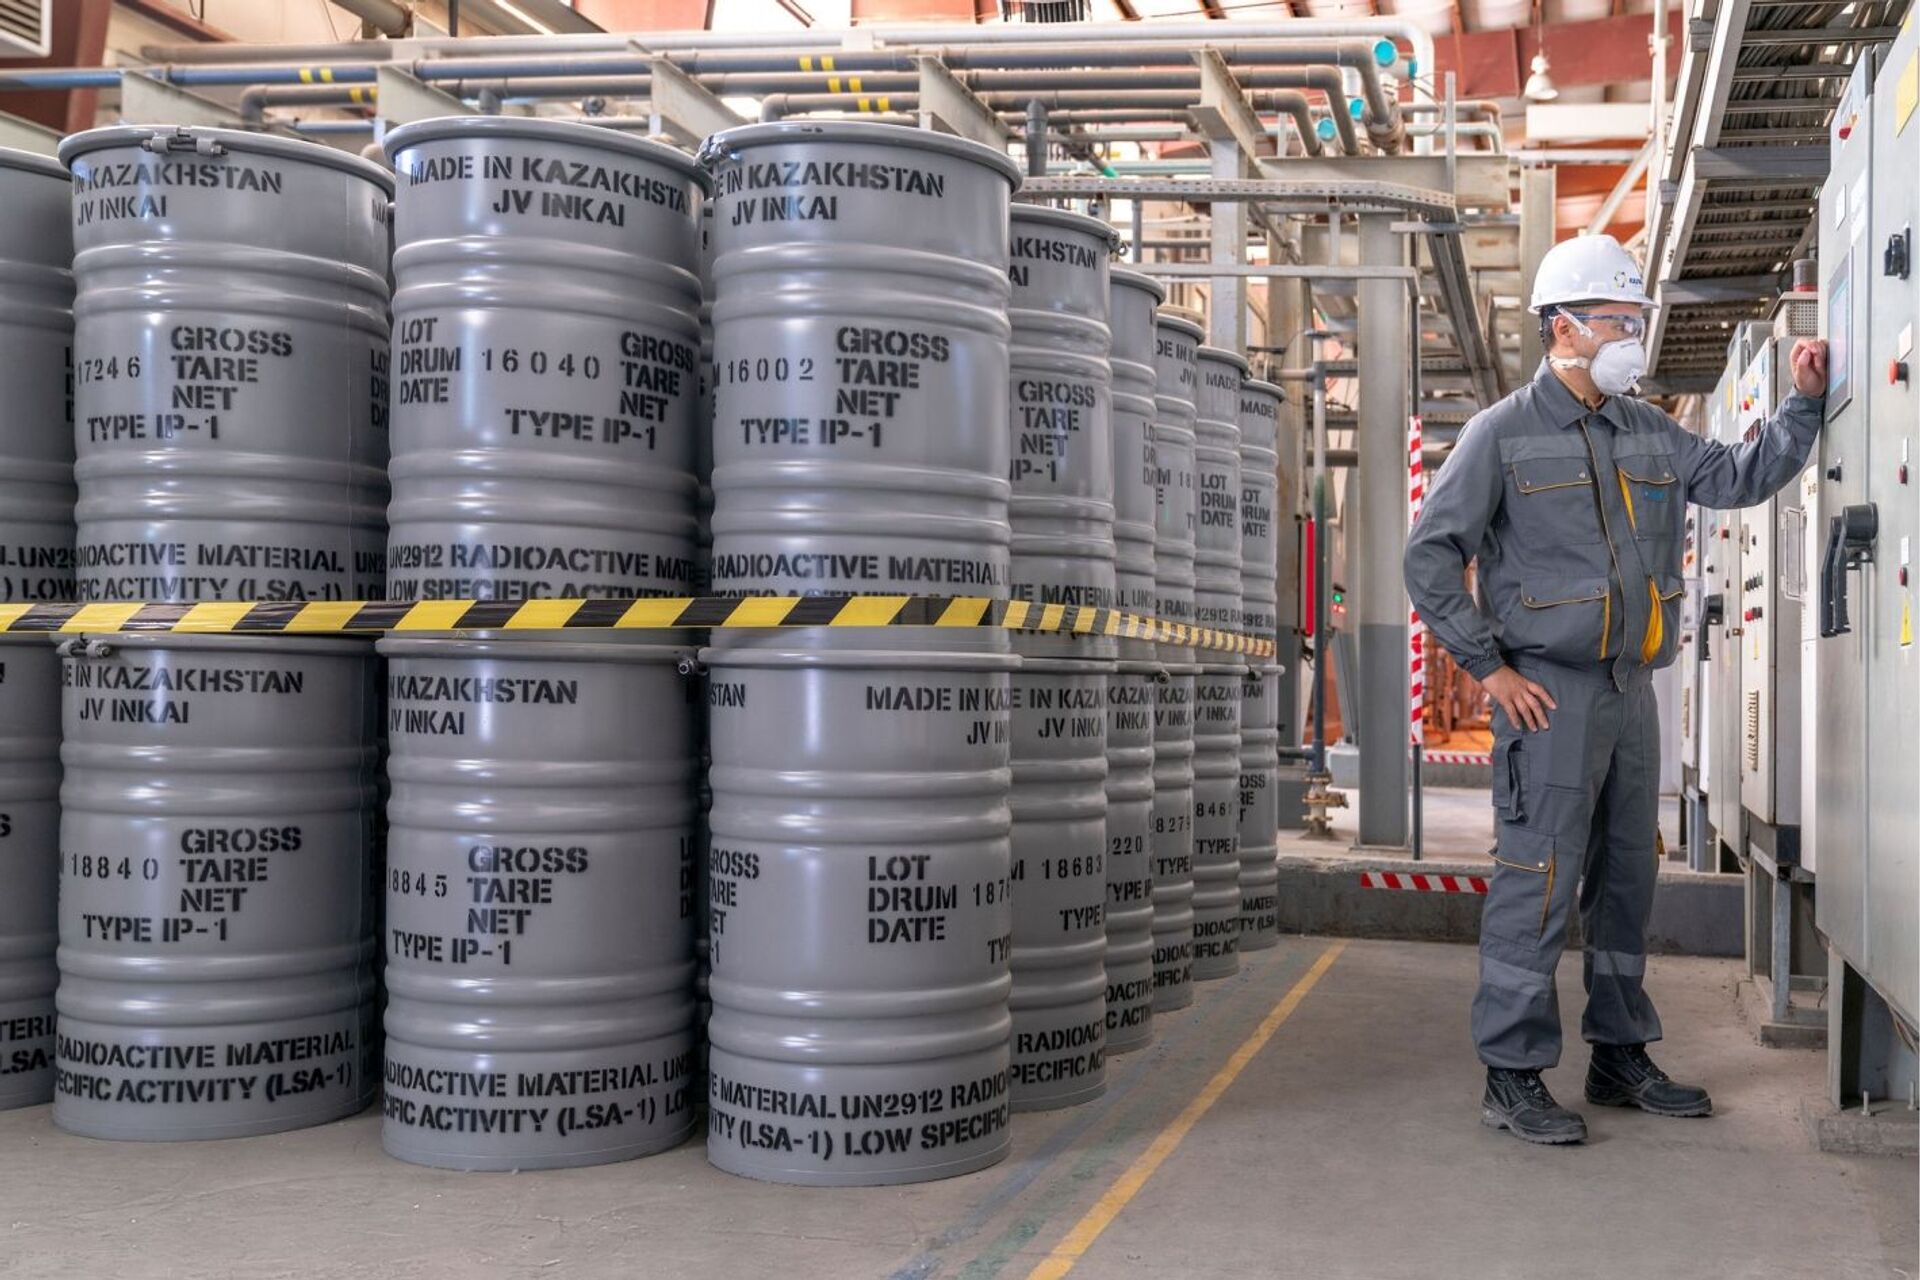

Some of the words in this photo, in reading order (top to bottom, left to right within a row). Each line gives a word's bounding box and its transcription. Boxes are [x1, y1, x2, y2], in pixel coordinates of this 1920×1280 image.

[88, 163, 282, 194] KAZAKHSTAN
[409, 155, 474, 187] MADE
[483, 154, 513, 180] IN
[727, 167, 743, 195] IN
[748, 161, 945, 199] KAZAKHSTAN
[77, 199, 95, 226] JV
[100, 196, 167, 221] INKAI
[492, 188, 533, 215] JV
[541, 191, 626, 228] INKAI
[732, 198, 757, 227] JV
[762, 196, 838, 223] INKAI
[401, 316, 439, 345] LOT
[77, 355, 141, 385] 17246
[170, 325, 293, 357] GROSS
[171, 354, 259, 383] TARE
[400, 346, 462, 375] DRUM
[481, 348, 601, 380] 16040
[619, 329, 695, 375] GROSS
[727, 356, 815, 384] 16002
[836, 325, 950, 363] GROSS
[619, 359, 681, 397] TARE
[835, 357, 920, 389] TARE
[1205, 371, 1238, 393] MADE
[171, 384, 239, 411] NET
[400, 377, 450, 406] DATE
[619, 390, 669, 423] NET
[835, 388, 901, 418] NET
[1018, 380, 1096, 409] GROSS
[87, 414, 147, 442] TYPE
[156, 414, 219, 440] IP-1
[504, 407, 595, 442] TYPE
[602, 417, 657, 451] IP-1
[739, 417, 810, 446] TYPE
[819, 418, 882, 449] IP-1
[1019, 406, 1080, 432] TARE
[1020, 432, 1069, 457] NET
[1200, 473, 1228, 491] LOT
[1200, 491, 1237, 511] DRUM
[1200, 509, 1234, 529] DATE
[197, 543, 345, 573] MATERIAL
[389, 544, 444, 570] UN2912
[450, 543, 650, 578] RADIOACTIVE
[717, 553, 879, 581] RADIOACTIVE
[888, 555, 1001, 586] MATERIAL
[104, 576, 229, 602] ACTIVITY
[237, 577, 342, 602] (LSA-1)
[389, 578, 418, 602] LOW
[422, 577, 552, 602] SPECIFIC
[75, 664, 92, 688] IN
[97, 666, 304, 695] KAZAKHSTAN
[397, 675, 578, 705] KAZAKHSTAN
[79, 697, 105, 722] JV
[112, 698, 190, 725] INKAI
[865, 684, 952, 713] MADE
[959, 687, 980, 712] IN
[1029, 686, 1053, 709] IN
[405, 709, 465, 736] INKAI
[966, 720, 991, 745] JV
[1038, 716, 1066, 739] JV
[71, 853, 160, 882] 18840
[180, 826, 303, 855] GROSS
[1196, 838, 1231, 854] TYPE
[179, 857, 269, 884] TARE
[387, 866, 448, 898] 18845
[467, 845, 589, 874] GROSS
[710, 848, 760, 880] ROSS
[868, 853, 931, 882] LOT
[1157, 855, 1189, 876] TYPE
[180, 887, 248, 913] NET
[466, 876, 553, 904] TARE
[867, 883, 958, 914] DRUM
[82, 913, 153, 943] TYPE
[162, 917, 229, 943] IP-1
[467, 907, 532, 935] NET
[867, 914, 946, 944] DATE
[1059, 904, 1101, 932] TYPE
[391, 928, 443, 963] TYPE
[451, 937, 512, 965] IP-1
[58, 1032, 216, 1070] RADIOACTIVE
[226, 1028, 355, 1067] MATERIAL
[56, 1067, 112, 1101] ECIFIC
[115, 1074, 258, 1104] ACTIVITY
[264, 1061, 353, 1102] (LSA-1)
[517, 1062, 659, 1099] MATERIAL
[720, 1075, 838, 1119] MATERIAL
[841, 1087, 944, 1120] UN2912
[419, 1101, 549, 1134] ACTIVITY
[556, 1096, 656, 1137] (LSA-1)
[739, 1118, 834, 1162] (LSA-1)
[845, 1126, 913, 1156] LOW
[920, 1102, 1008, 1150] SPECIFIC
